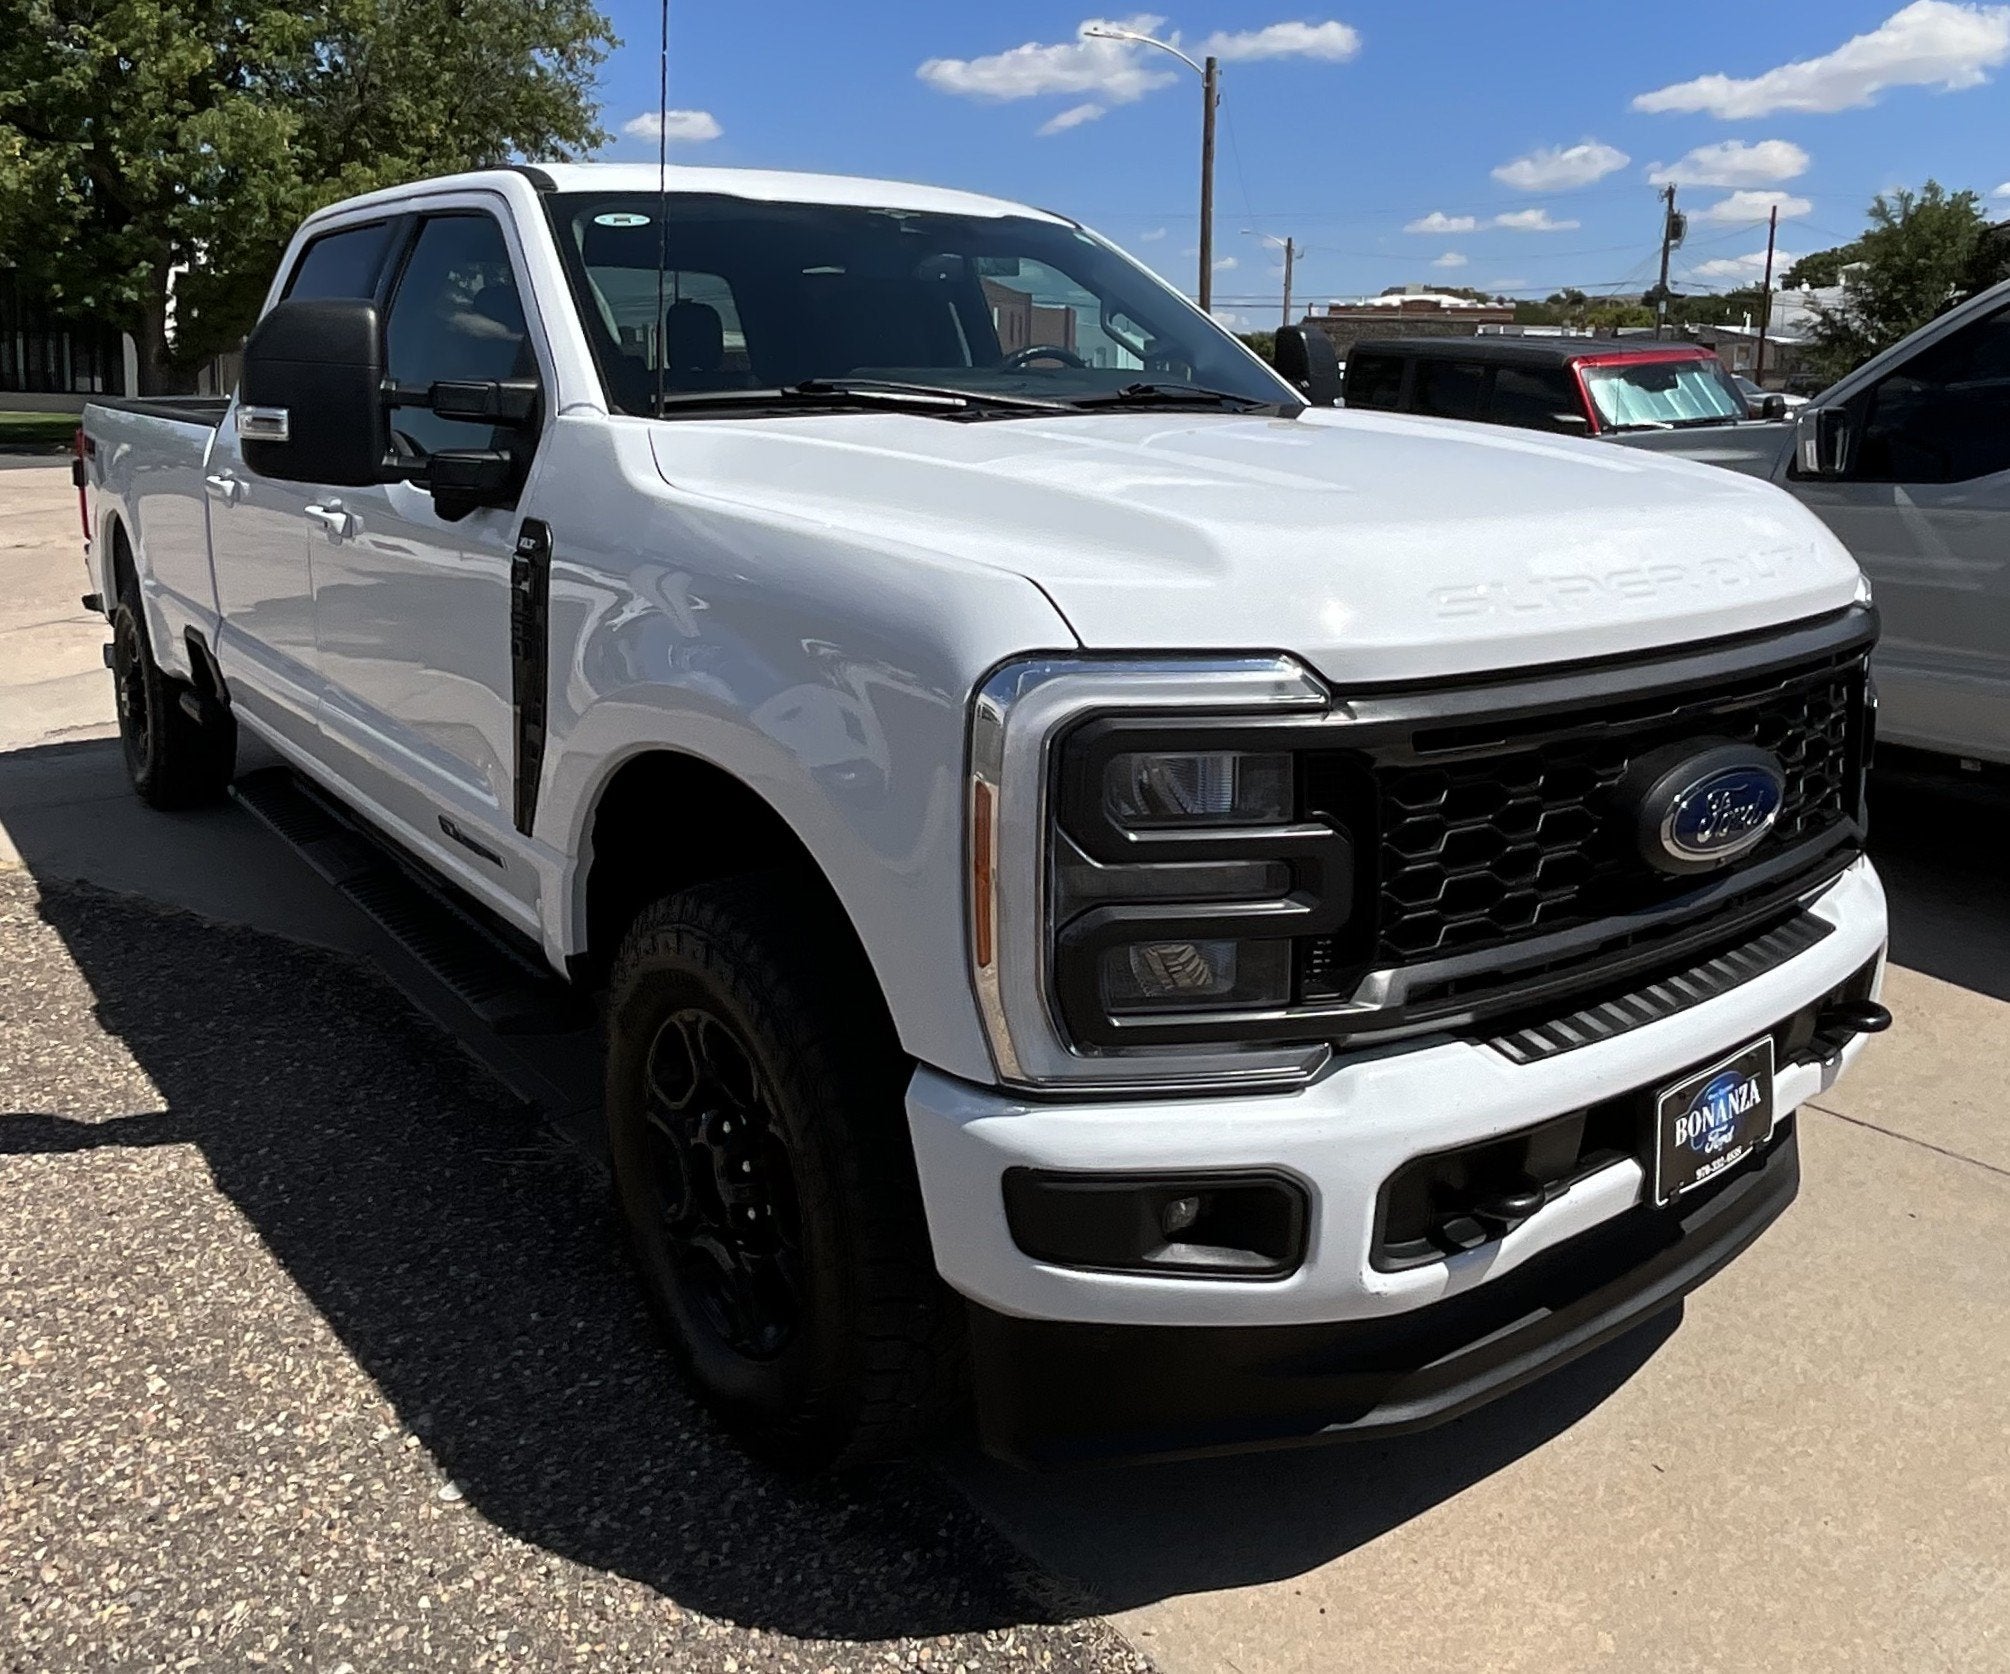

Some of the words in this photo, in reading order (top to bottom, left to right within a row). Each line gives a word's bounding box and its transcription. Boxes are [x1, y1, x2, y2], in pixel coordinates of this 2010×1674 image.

[1698, 783, 1765, 843] Ford
[1674, 1078, 1762, 1148] BONANZA
[1704, 1124, 1735, 1154] Ford
